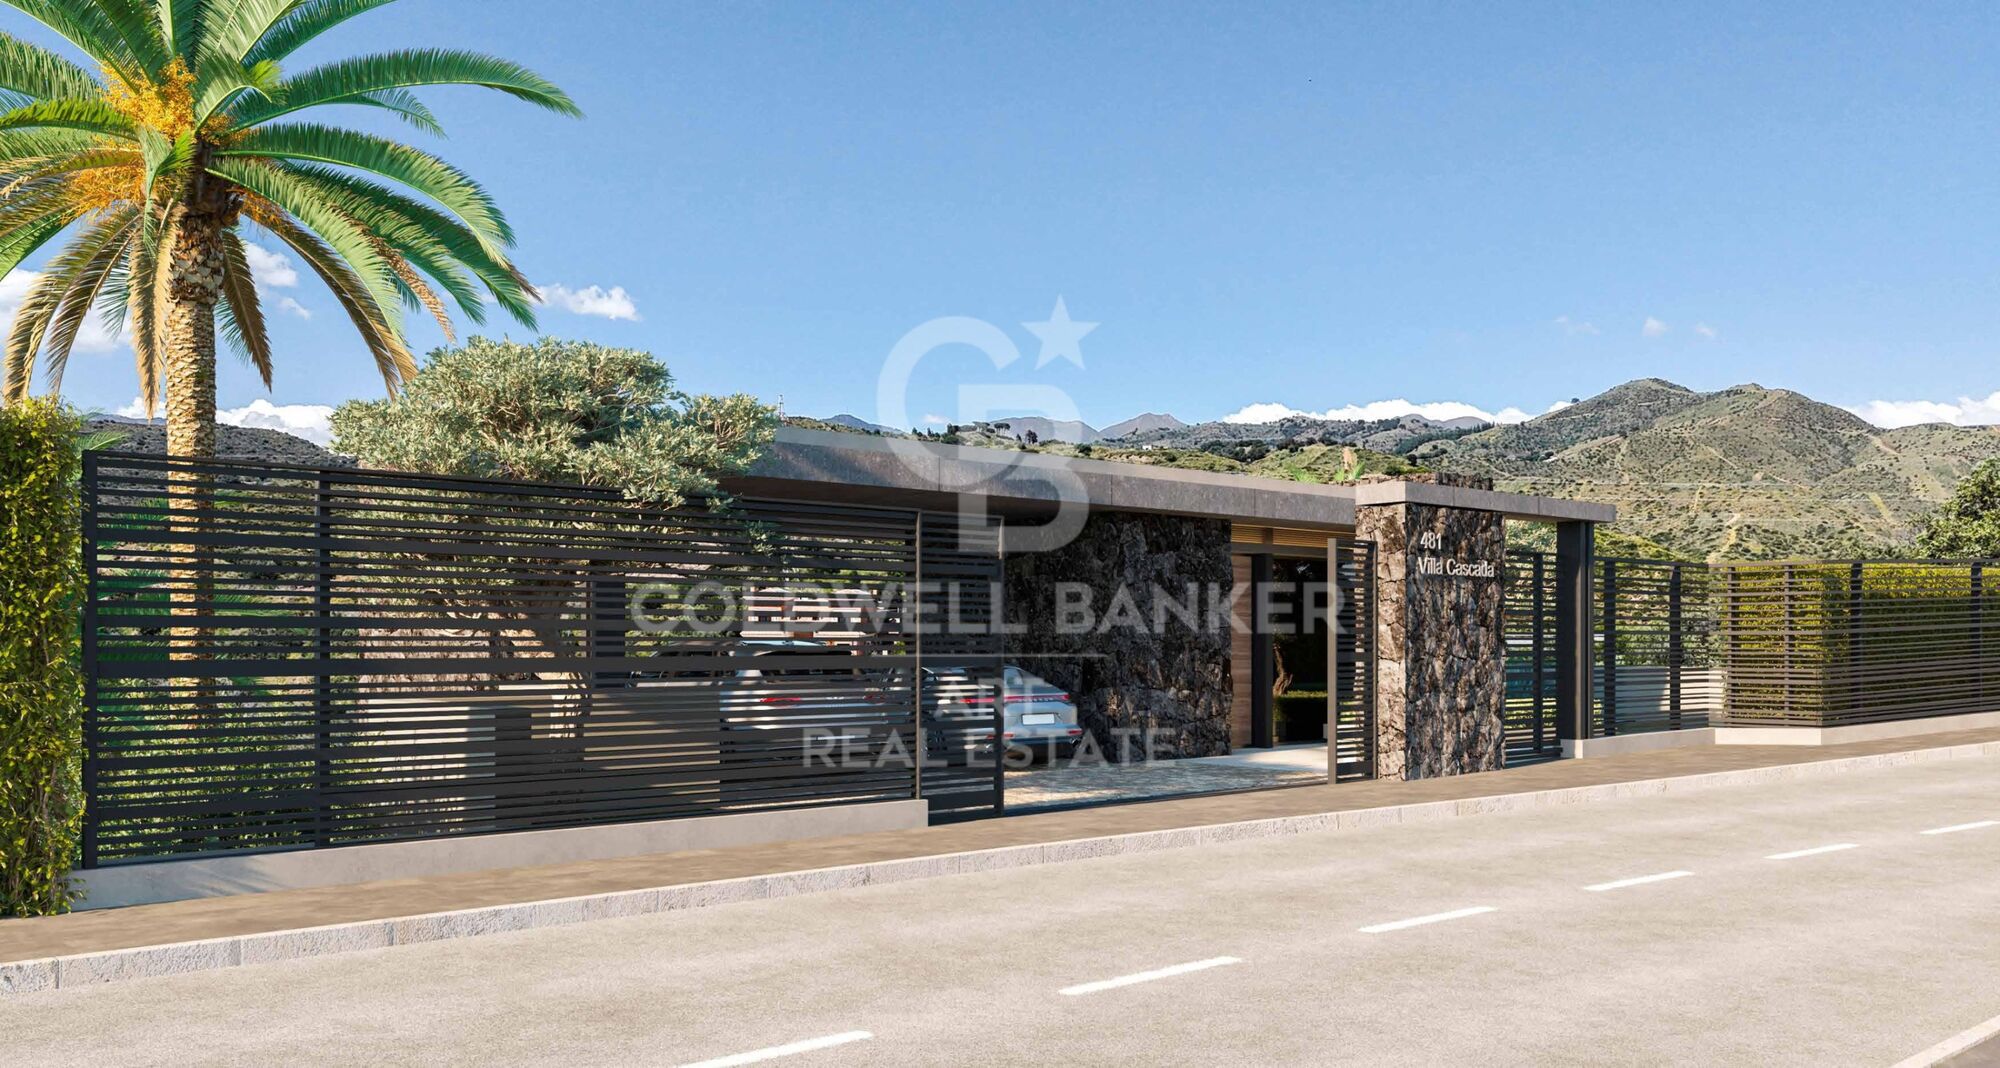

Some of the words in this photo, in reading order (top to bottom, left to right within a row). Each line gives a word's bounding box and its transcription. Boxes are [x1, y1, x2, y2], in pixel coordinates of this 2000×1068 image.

[1420, 531, 1441, 549] 481
[1418, 557, 1443, 575] Villa
[1446, 559, 1495, 577] Cascada
